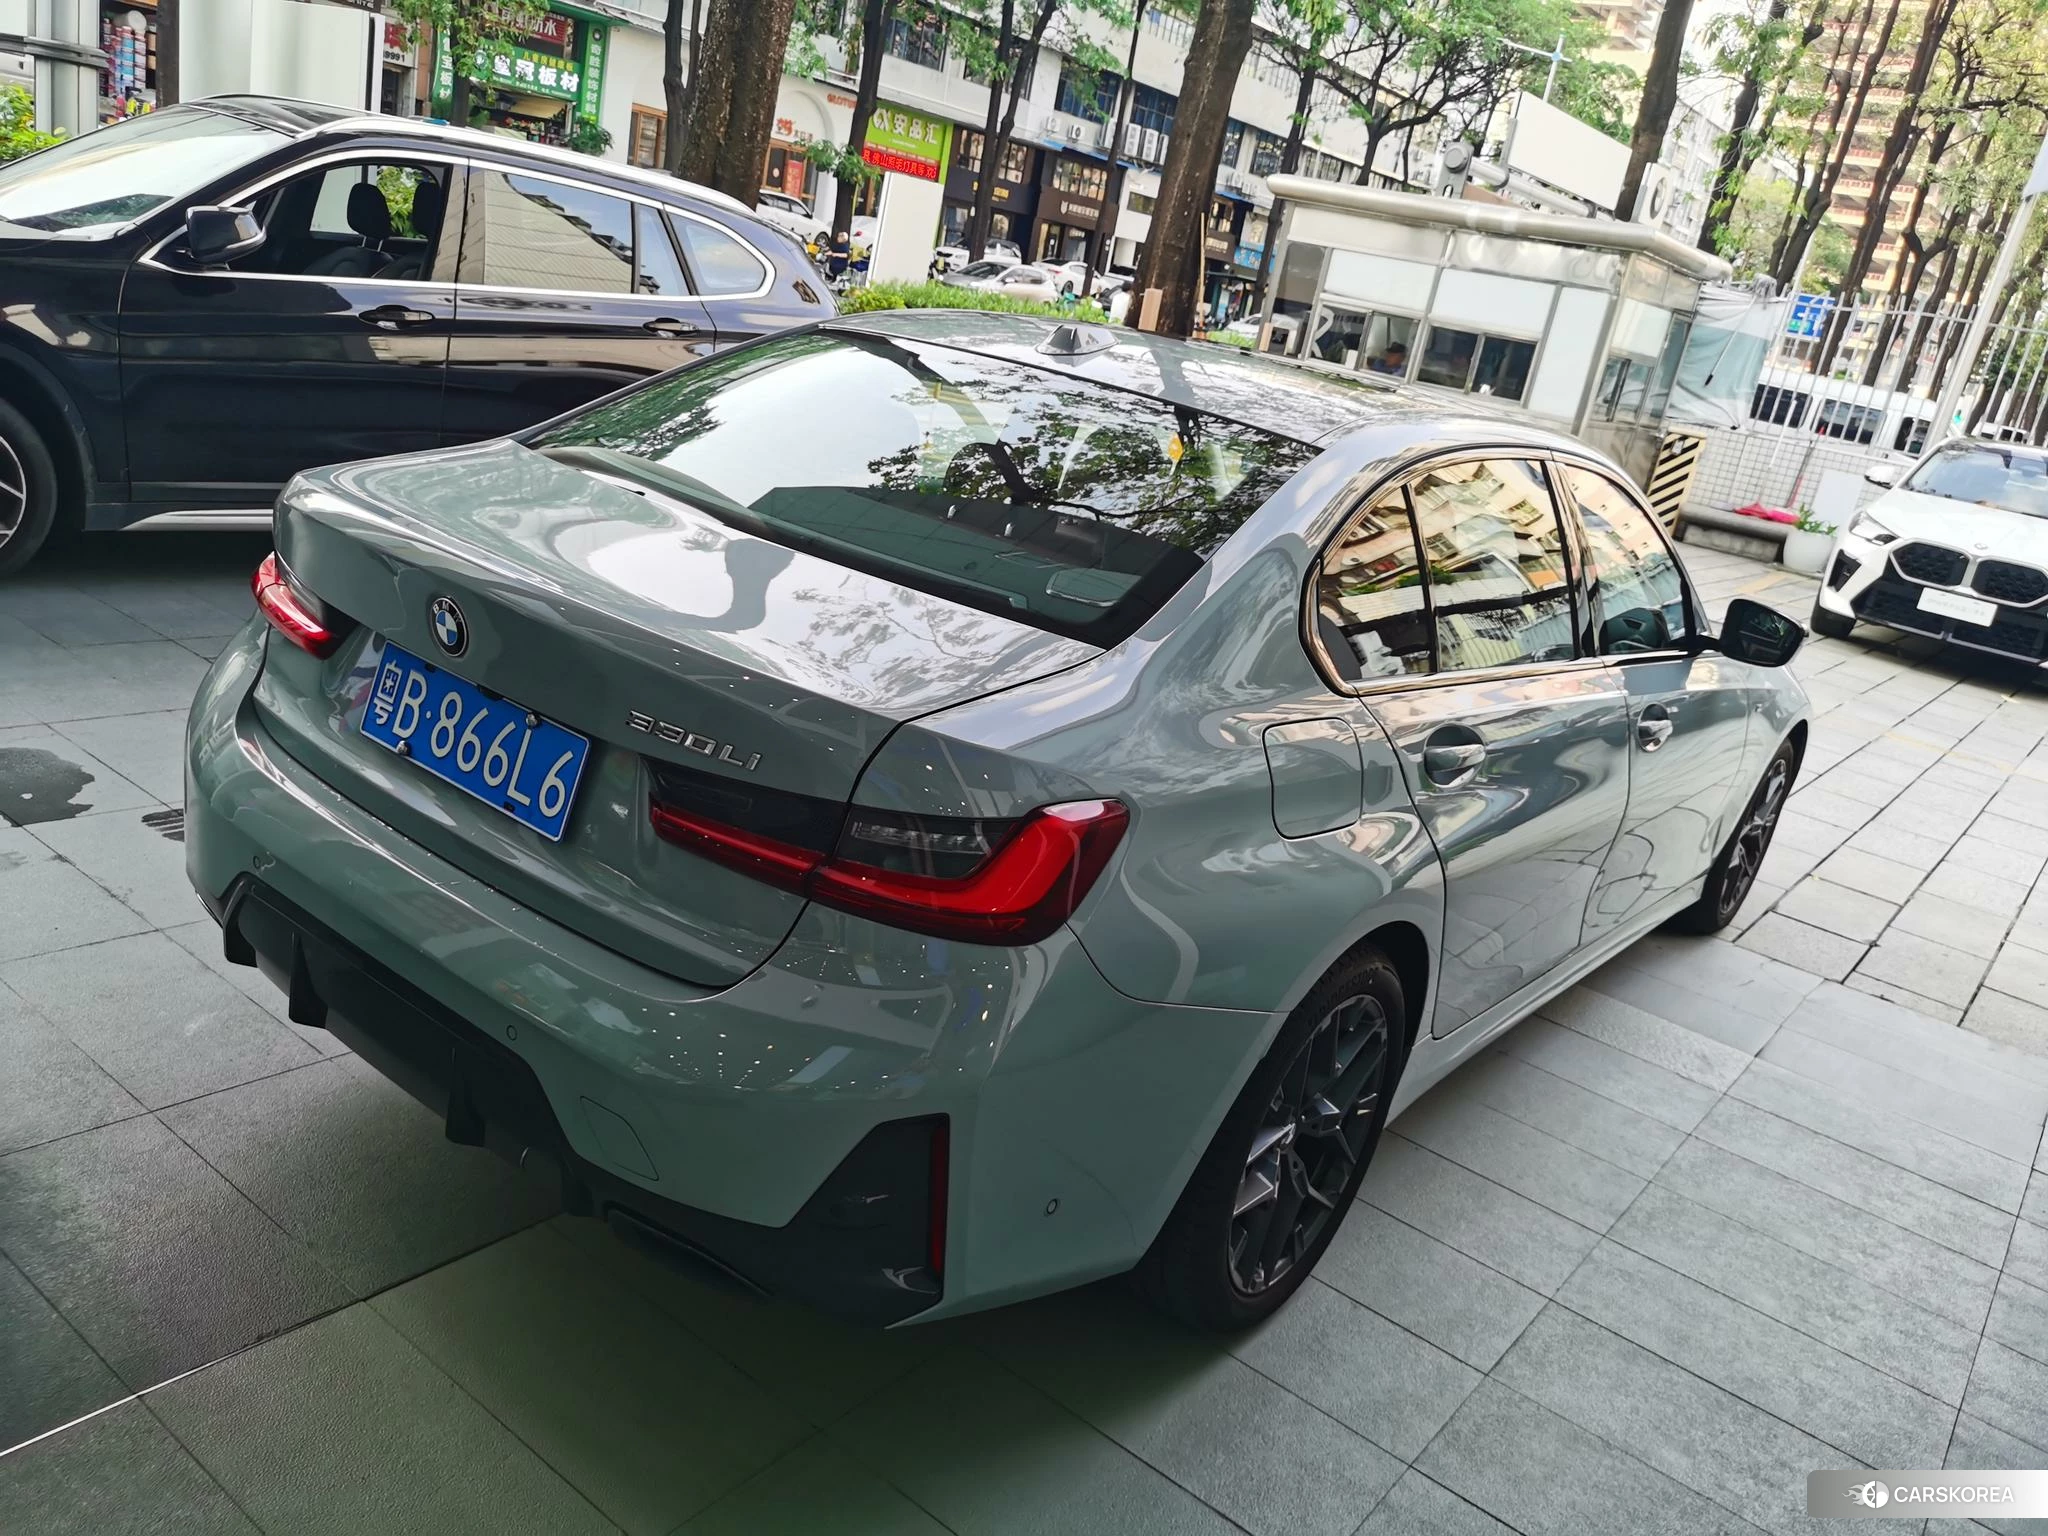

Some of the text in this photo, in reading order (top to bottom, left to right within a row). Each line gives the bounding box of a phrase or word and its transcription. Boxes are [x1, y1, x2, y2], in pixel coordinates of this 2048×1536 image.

[893, 113, 940, 145] 安品汇
[627, 710, 761, 770] 330Li
